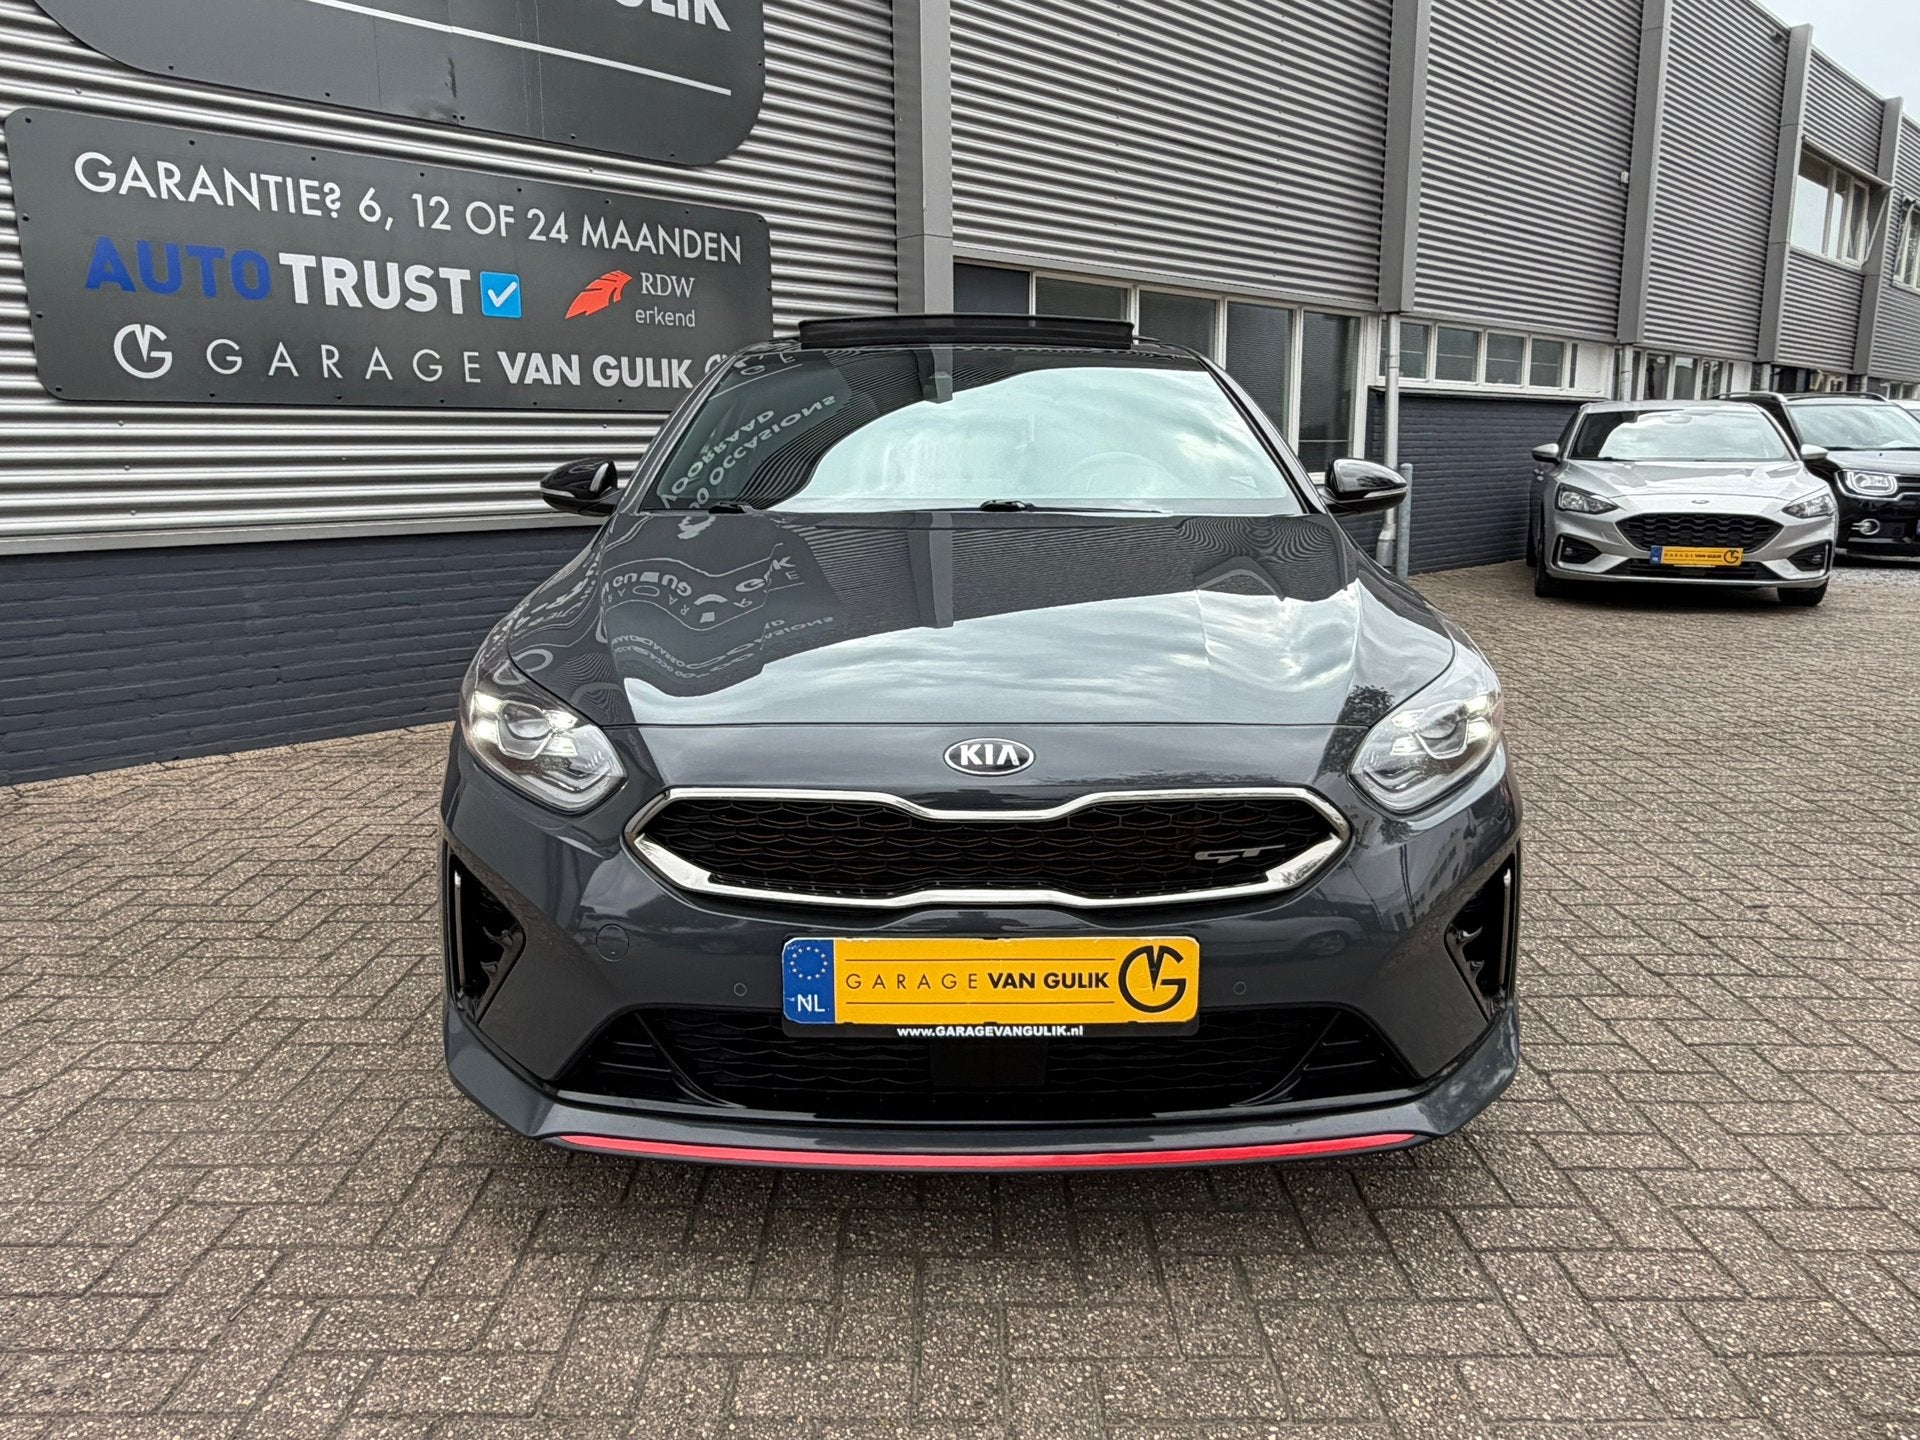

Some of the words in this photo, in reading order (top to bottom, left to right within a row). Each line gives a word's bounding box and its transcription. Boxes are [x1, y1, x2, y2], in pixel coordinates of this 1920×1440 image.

[75, 152, 341, 219] GARANTIE?
[359, 187, 393, 230] 6,
[412, 194, 451, 230] 12
[466, 201, 514, 237] OF
[527, 209, 568, 243] 24
[582, 215, 741, 264] MAANDEN
[86, 237, 270, 300] AUTO
[279, 253, 470, 314] TRUST
[641, 273, 694, 298] RDW
[635, 307, 695, 327] erkend
[207, 339, 481, 383] GARAGE
[497, 351, 580, 386] VAN
[593, 355, 693, 388] GULIK
[960, 743, 1020, 766] KIA
[846, 973, 978, 989] GARAGE
[988, 972, 1035, 989] VAN
[1044, 972, 1110, 989] GULIK
[797, 994, 825, 1011] NL
[897, 1025, 1084, 1037] www.GARAGEVANGULIK.nl
